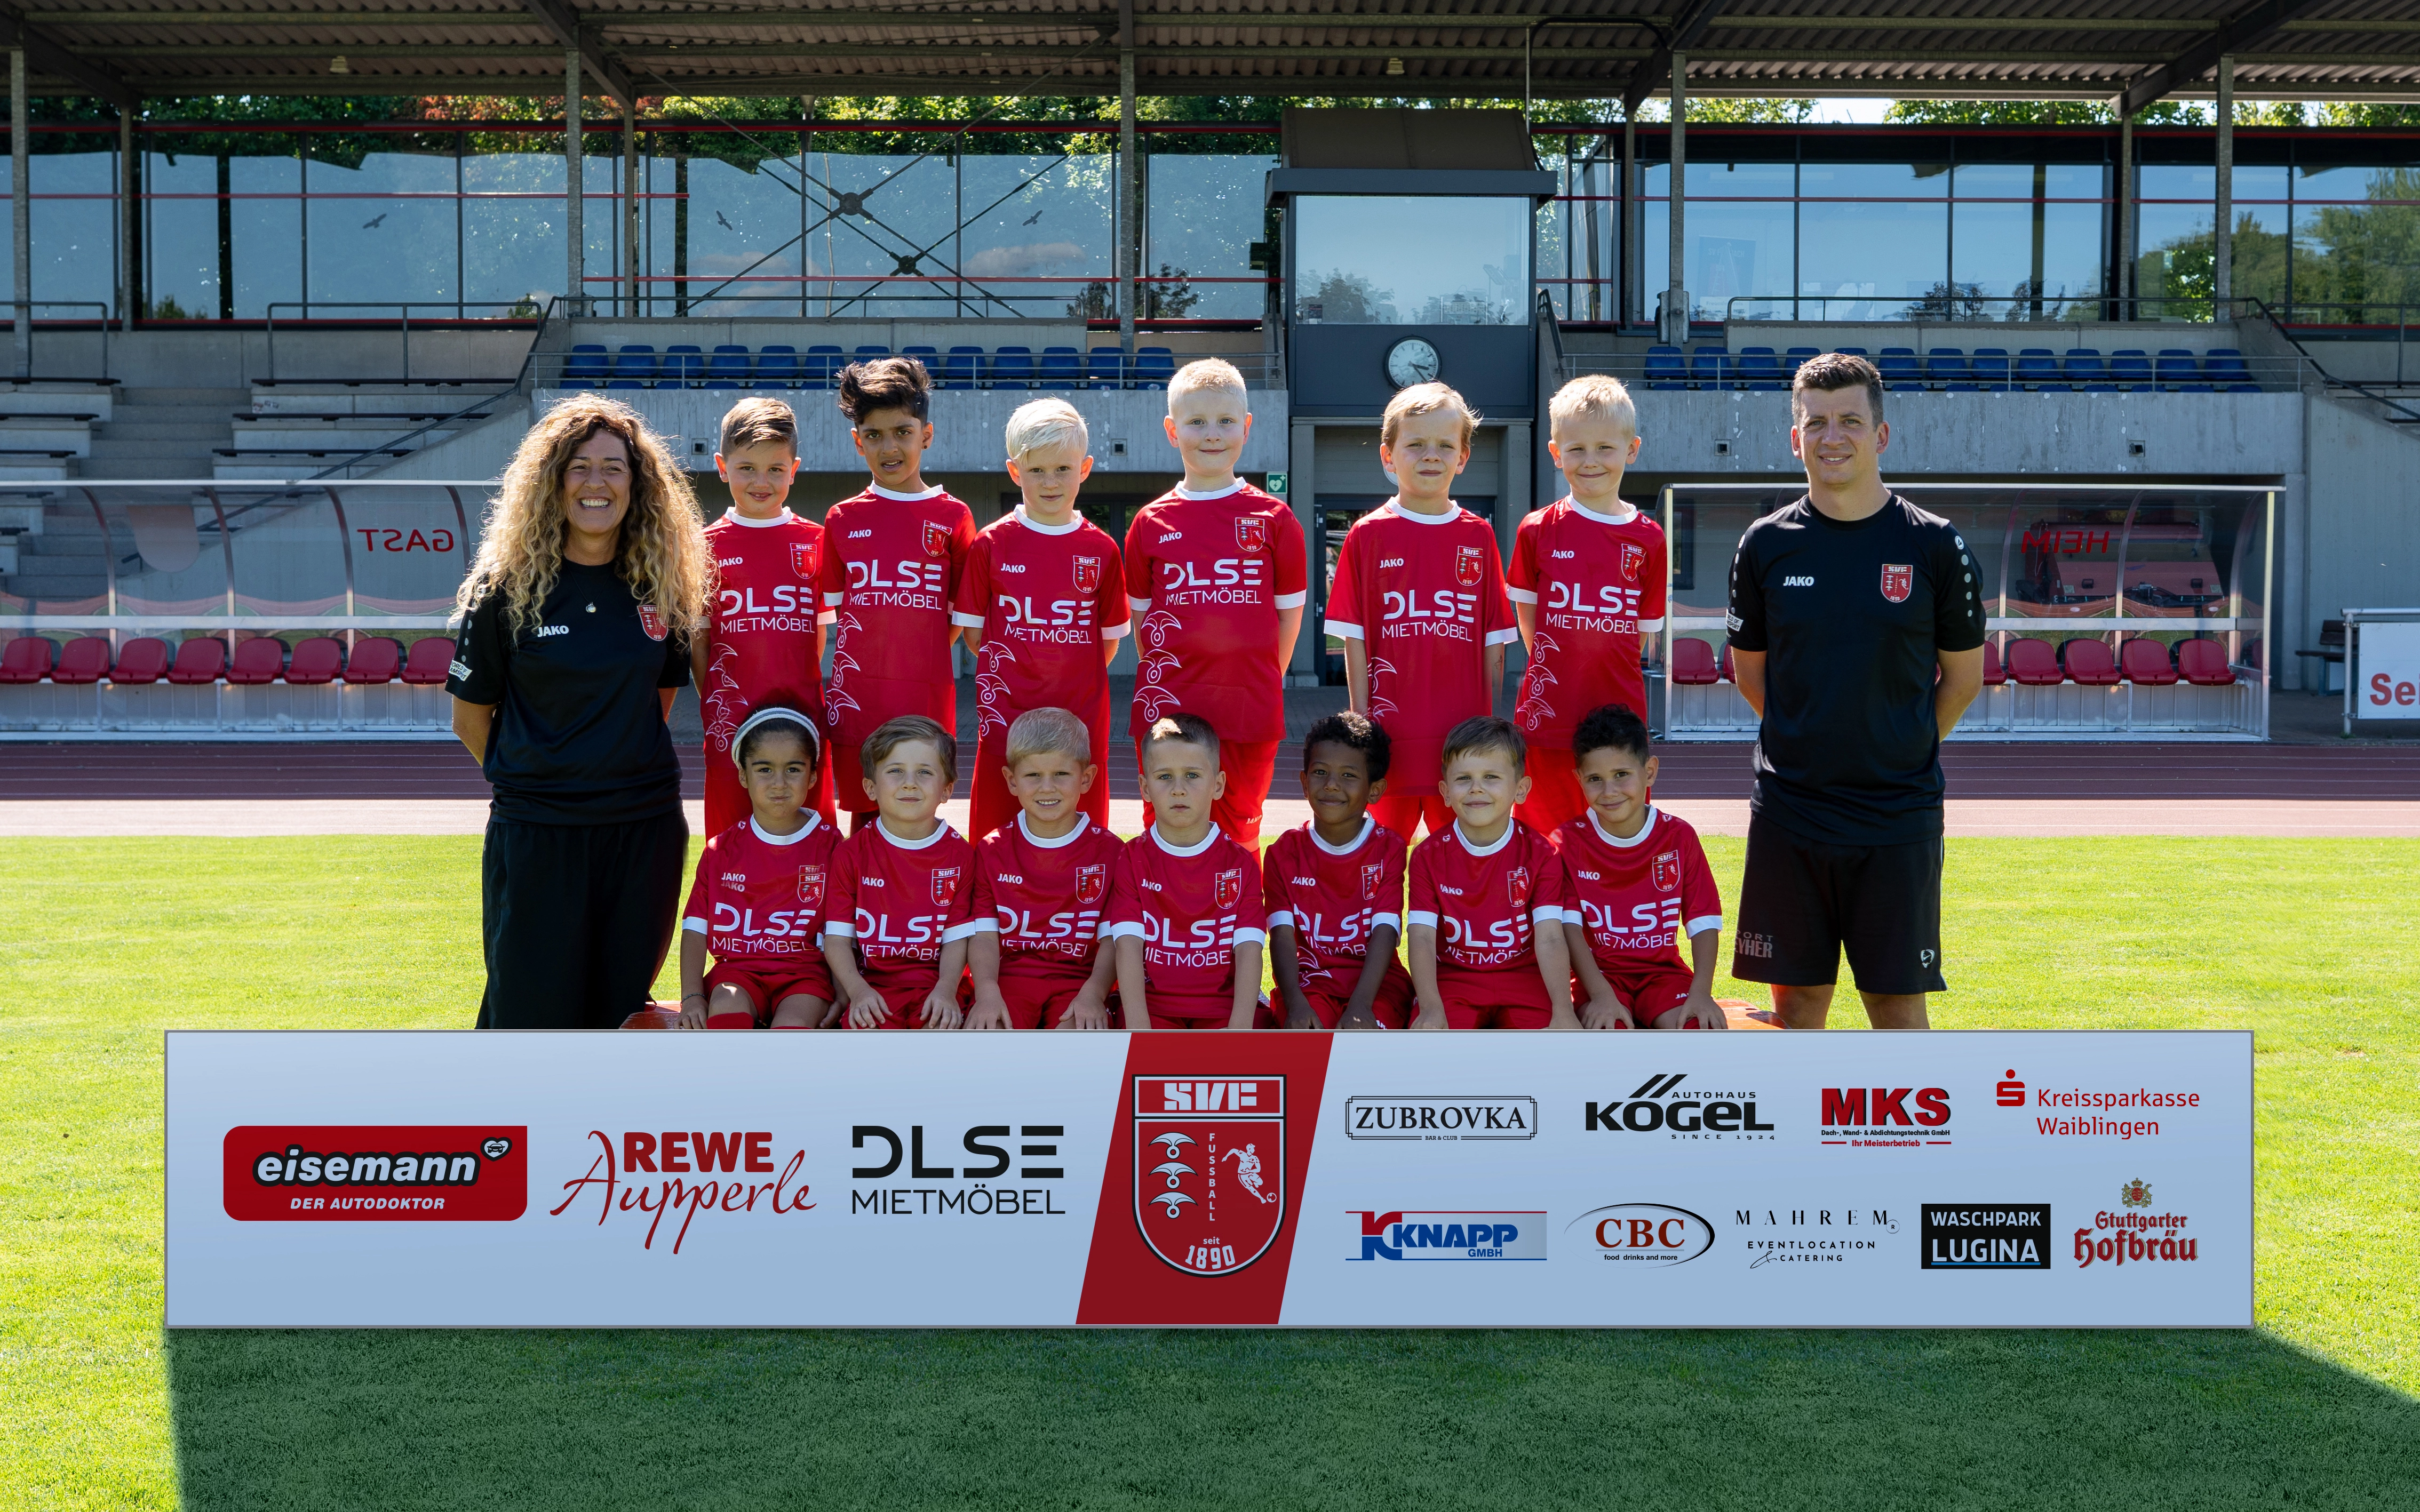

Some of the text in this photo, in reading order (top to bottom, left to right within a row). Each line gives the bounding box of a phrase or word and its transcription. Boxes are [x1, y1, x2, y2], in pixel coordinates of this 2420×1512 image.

[848, 529, 872, 538] JAKO
[1159, 532, 1182, 543] JAKO
[718, 557, 743, 567] JAKO
[1380, 558, 1404, 569] JAKO
[1551, 549, 1574, 559] JAKO
[847, 559, 942, 592] DLSE
[1001, 563, 1026, 573] JAKO
[1164, 559, 1263, 589] DLSE
[1783, 576, 1814, 587] JAKO
[720, 585, 814, 616] DLSE
[849, 590, 942, 610] MIETMÖBEL
[1166, 587, 1262, 605] MIETMÖBEL
[1383, 589, 1477, 623] DLSE
[1548, 581, 1641, 617] DLSE
[999, 594, 1095, 625] DLSE
[537, 626, 569, 637] JAKO
[721, 614, 815, 634] MIETMÖBEL
[1382, 620, 1472, 642] MIETMÖBEL
[1546, 613, 1638, 634] MIETMÖBEL
[2370, 673, 2420, 706] Se
[1658, 853, 1674, 862] SVF
[721, 873, 746, 882] JAKO
[997, 873, 1023, 884] JAKO
[1141, 878, 1162, 892] JAKO
[1292, 876, 1316, 886] JAKO
[1578, 870, 1600, 881] JAKO
[713, 902, 816, 937] DLSE
[856, 907, 948, 943] DLSE
[996, 905, 1100, 939] DLSE
[1294, 903, 1372, 942] DLSE
[1580, 897, 1681, 933] DLSE
[1142, 910, 1237, 948] DLSE
[1443, 914, 1532, 947] DLSE
[713, 937, 814, 953] MIETMÖBEL
[1164, 1083, 1257, 1110] SVF
[1821, 1087, 1951, 1126] MKS
[2038, 1088, 2200, 1111] Kreissparkasse
[1356, 1107, 1527, 1129] ZUBROVKA
[2036, 1116, 2160, 1140] Waiblingen
[624, 1132, 774, 1173] REWE
[852, 1125, 1064, 1178] DLSE
[256, 1147, 477, 1182] eisemann
[1208, 1133, 1216, 1221] FUSSBALL
[290, 1198, 445, 1210] DER AUTODOKTOR
[550, 1130, 817, 1255] Aupperle
[852, 1183, 1065, 1215] MIETMÖBEL
[1736, 1210, 1888, 1225] MAHREM
[1930, 1211, 2042, 1227] WASCHPARK
[2095, 1210, 2188, 1233] Stuttgarter
[1203, 1236, 1220, 1245] seit
[1392, 1224, 1518, 1248] KNAPP
[1595, 1218, 1685, 1249] CBC
[1748, 1241, 1876, 1249] EVENTLOCATION
[1185, 1245, 1236, 1269] 1890
[1468, 1248, 1503, 1258] GMBH
[1932, 1238, 2040, 1262] LUGINA
[2073, 1227, 2199, 1269] Hofbräu
